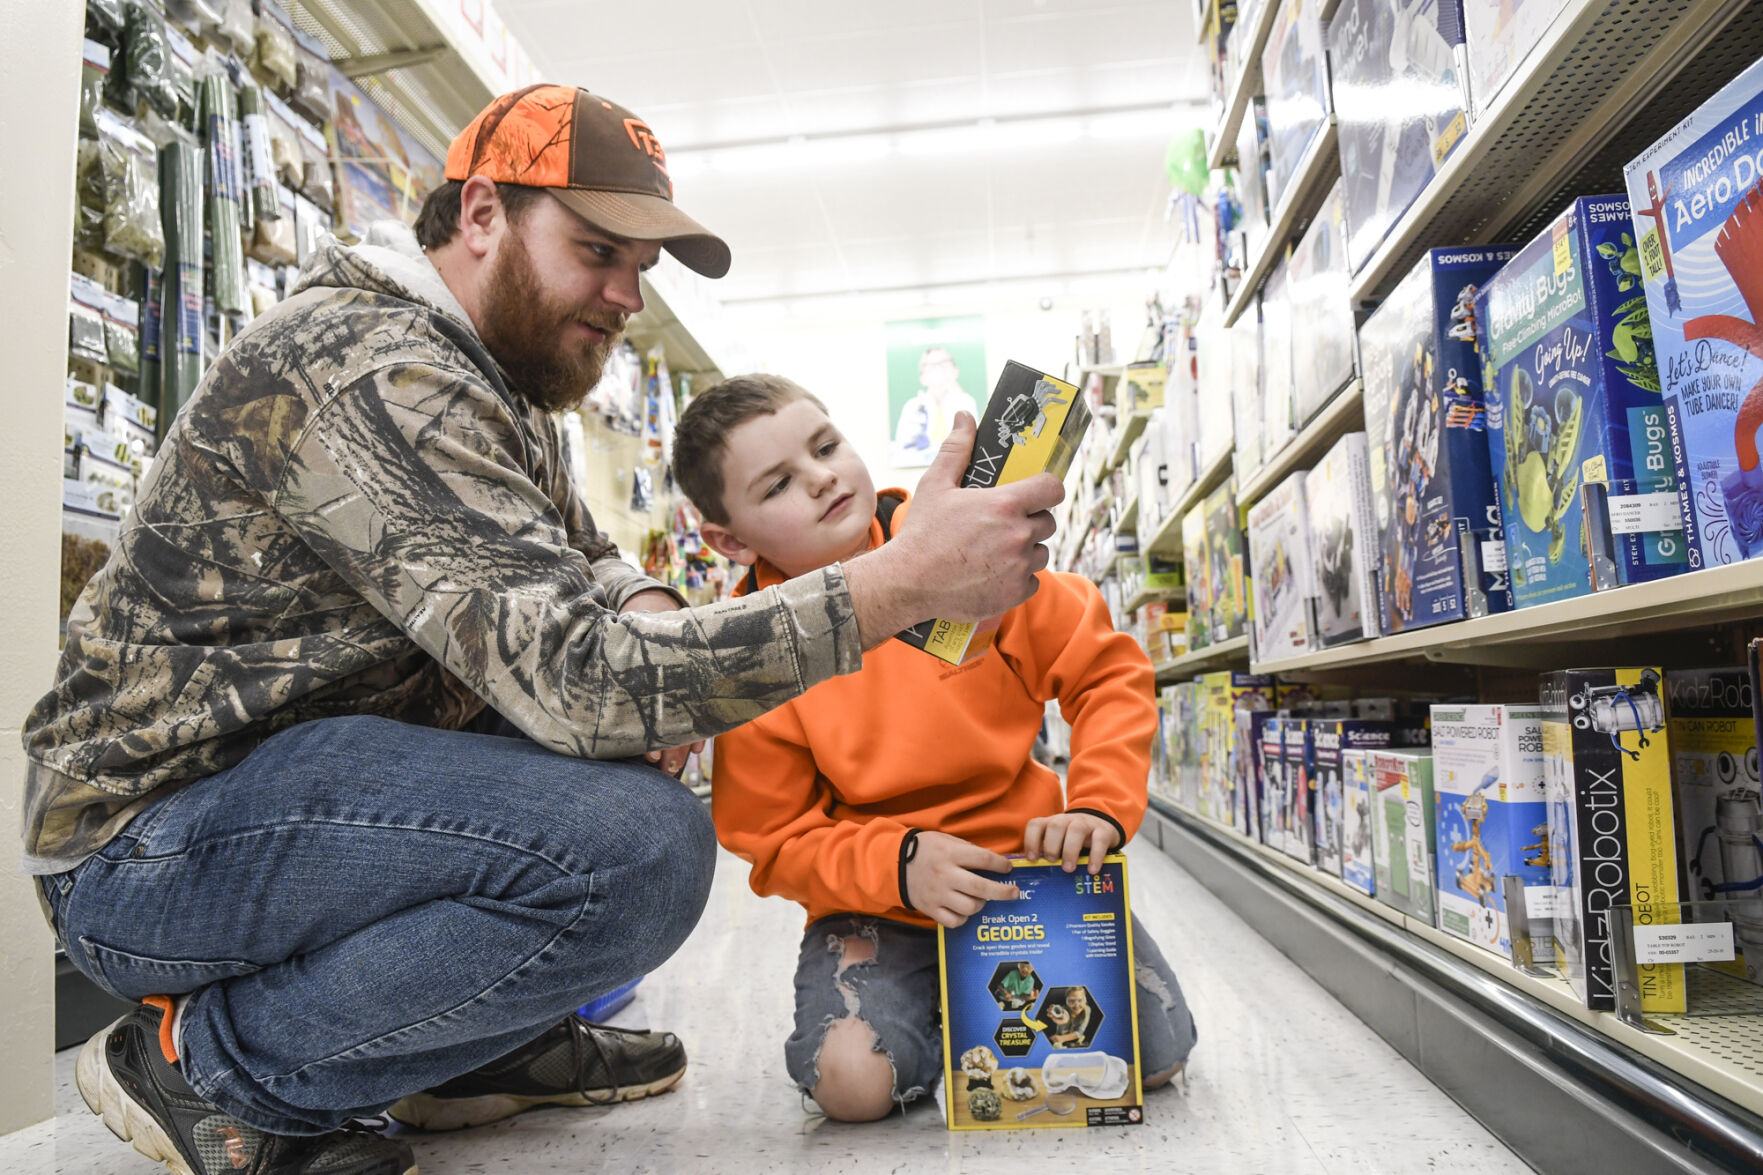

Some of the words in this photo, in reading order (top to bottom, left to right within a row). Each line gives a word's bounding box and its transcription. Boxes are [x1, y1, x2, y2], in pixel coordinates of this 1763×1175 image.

[1642, 126, 1681, 163] EXPERIMENT
[1682, 117, 1694, 131] KIT
[1683, 118, 1750, 191] INCREDIBLE
[1588, 201, 1630, 213] OSMOS
[1591, 211, 1633, 223] HAMES
[1674, 176, 1731, 233] Aero
[1643, 233, 1657, 253] OVER
[1649, 243, 1661, 261] FOOT
[1547, 289, 1582, 321] MicroBot
[1535, 342, 1564, 385] Going
[1563, 327, 1592, 368] Up!
[1666, 350, 1693, 392] Let's
[1694, 339, 1751, 373] Dance!
[1681, 378, 1700, 401] MAKE
[1701, 374, 1721, 392] YOUR
[1723, 374, 1742, 392] OWN
[1684, 396, 1704, 418] TUBE
[1706, 392, 1739, 413] DANCER!
[1644, 412, 1666, 472] Bugs
[1666, 404, 1683, 465] KOSMOS
[1677, 466, 1685, 478] &
[1679, 481, 1695, 544] THAMES
[1433, 725, 1446, 738] SALT
[1446, 726, 1476, 739] POWERED
[1478, 727, 1500, 740] ROBOT
[1075, 881, 1114, 895] STEM
[981, 914, 1006, 924] Break
[1007, 914, 1030, 925] Open
[1031, 913, 1038, 922] 2
[976, 925, 1045, 942] GEODES
[1643, 976, 1657, 1000] TIN
[999, 1038, 1032, 1046] TREASURE
[216, 1125, 251, 1170] FILA
